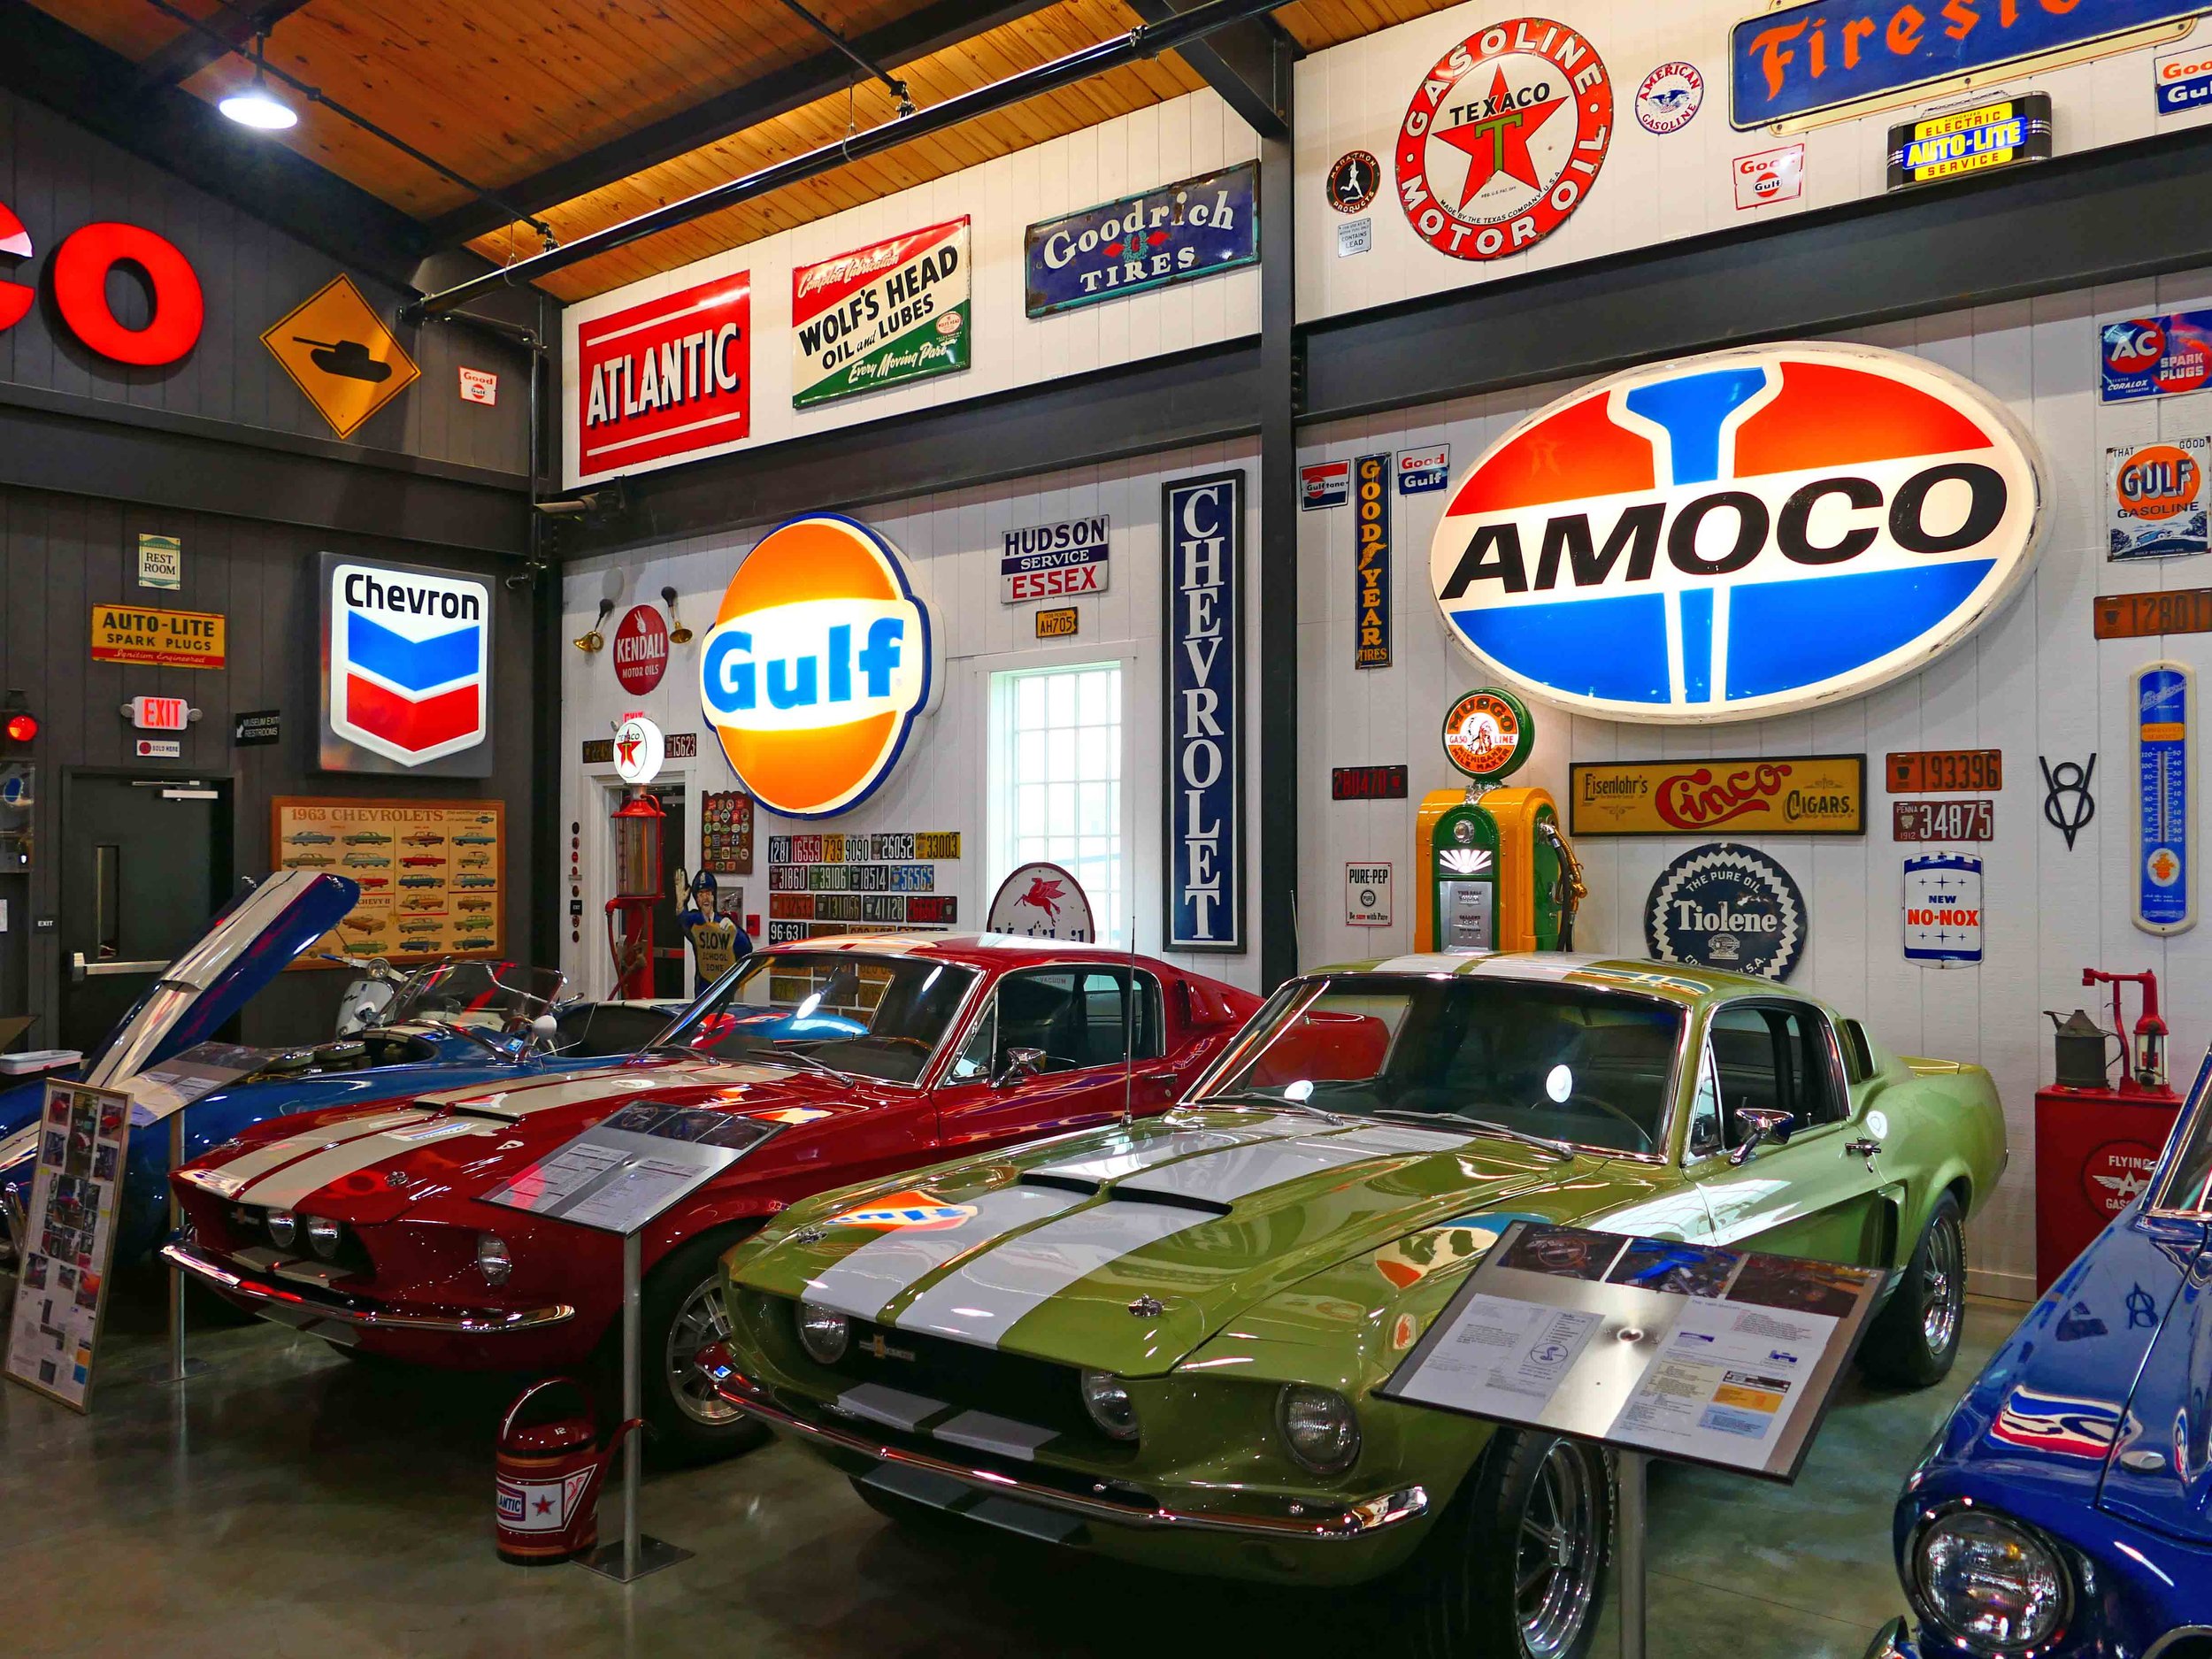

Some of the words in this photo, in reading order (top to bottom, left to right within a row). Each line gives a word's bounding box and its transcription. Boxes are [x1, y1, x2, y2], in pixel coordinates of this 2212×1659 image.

[1748, 0, 2079, 102] Firest
[1405, 22, 1603, 138] GASOLINE
[2162, 60, 2212, 80] Goo
[1640, 65, 1701, 102] AMERICAN
[2168, 80, 2212, 103] Gu
[1449, 81, 1550, 127] TEXACO
[1642, 104, 1696, 131] GASOLINE
[1926, 111, 2001, 136] ELECTRIC
[1475, 113, 1523, 172] T
[1907, 120, 2021, 167] AUTO-LITE
[1331, 152, 1377, 179] MARATHON
[1928, 152, 1999, 176] SERVICE
[1402, 173, 1538, 254] MOTOR
[1551, 124, 1608, 211] OIL
[1755, 180, 1780, 191] Gulf
[1333, 190, 1375, 213] PRODUCTS
[1440, 199, 1457, 216] MADE
[1483, 214, 1507, 224] TEXAS
[1508, 193, 1541, 219] COMPANY
[1044, 190, 1234, 270] Goodrich
[1341, 231, 1367, 242] CONTAINS
[1345, 239, 1363, 249] LEAD
[1079, 246, 1195, 293] TIRES
[799, 289, 879, 357] WOLF'S
[886, 245, 959, 309] HEAD
[822, 340, 855, 370] OIL
[856, 330, 877, 353] and
[879, 293, 934, 339] LUBES
[2110, 330, 2157, 362] AC
[849, 359, 880, 384] Every
[877, 349, 918, 378] Moving
[2160, 352, 2204, 369] SPARK
[464, 372, 493, 385] Good
[586, 322, 739, 427] ATLANTIC
[2160, 365, 2204, 381] PLUGS
[2108, 379, 2148, 391] CORALOX
[2113, 447, 2134, 458] THAT
[2179, 439, 2205, 449] GOOD
[1402, 453, 1445, 470] Good
[1404, 471, 1442, 488] Gulf
[2122, 458, 2193, 501] GULF
[2117, 501, 2200, 518] GASOLINE
[1005, 518, 1105, 557] HUDSON
[1439, 462, 2008, 601] AMOCO
[144, 563, 175, 575] ROOM
[146, 552, 173, 565] REST
[1020, 549, 1089, 570] SERVICE
[1012, 565, 1097, 599] ESSEX
[345, 573, 480, 621] Chevron
[103, 612, 215, 638] AUTO-LITE
[1040, 616, 1072, 634] AH705
[107, 634, 156, 647] SPARK
[165, 638, 211, 651] PLUGS
[617, 632, 665, 664] KENDALL
[157, 652, 206, 664] Engineered
[703, 617, 904, 713] Gulf
[1358, 648, 1387, 662] TIRES
[622, 666, 643, 679] MOTOR
[644, 664, 659, 676] OILS
[142, 698, 181, 727] EXIT
[1179, 487, 1225, 939] CHEVROLET
[1449, 697, 1514, 732] MUSGO
[244, 727, 278, 738] RESTROOMS
[1449, 735, 1468, 744] GASO
[672, 735, 695, 757] 15623
[1921, 754, 1999, 790] 193396
[1585, 772, 1647, 803] Eisenlohr's
[1655, 764, 1793, 830] Cinco
[291, 809, 326, 822] 1963
[332, 809, 444, 823] CHEVROLETS
[1919, 803, 1991, 840] 34875
[882, 835, 913, 859] 26052
[926, 834, 957, 858] 33003
[1900, 832, 1916, 841] 1912
[771, 841, 789, 863] 1281
[794, 840, 820, 862] 16559
[824, 839, 842, 862] 739
[845, 839, 869, 862] 9090
[779, 867, 805, 890] 31860
[819, 867, 846, 889] 39106
[860, 867, 887, 890] 18514
[1349, 869, 1388, 885] PURE-PEP
[1686, 875, 1709, 893] THE
[1710, 871, 1741, 882] PURE
[1743, 877, 1763, 894] OIL
[874, 897, 903, 920] 41128
[1928, 895, 1957, 904] NEW
[1366, 911, 1377, 920] with
[1377, 912, 1388, 921] Pure
[1673, 899, 1778, 933] Tiolene
[1907, 909, 1979, 927] NO-NOX
[699, 931, 730, 950] SLOW
[771, 924, 803, 941] 96-631
[703, 951, 728, 962] SCHOOL
[706, 963, 725, 972] ZONE
[2108, 1156, 2151, 1169] FLYING
[499, 1494, 521, 1512] ANTIC
[1601, 1446, 1615, 1568] oodrich
